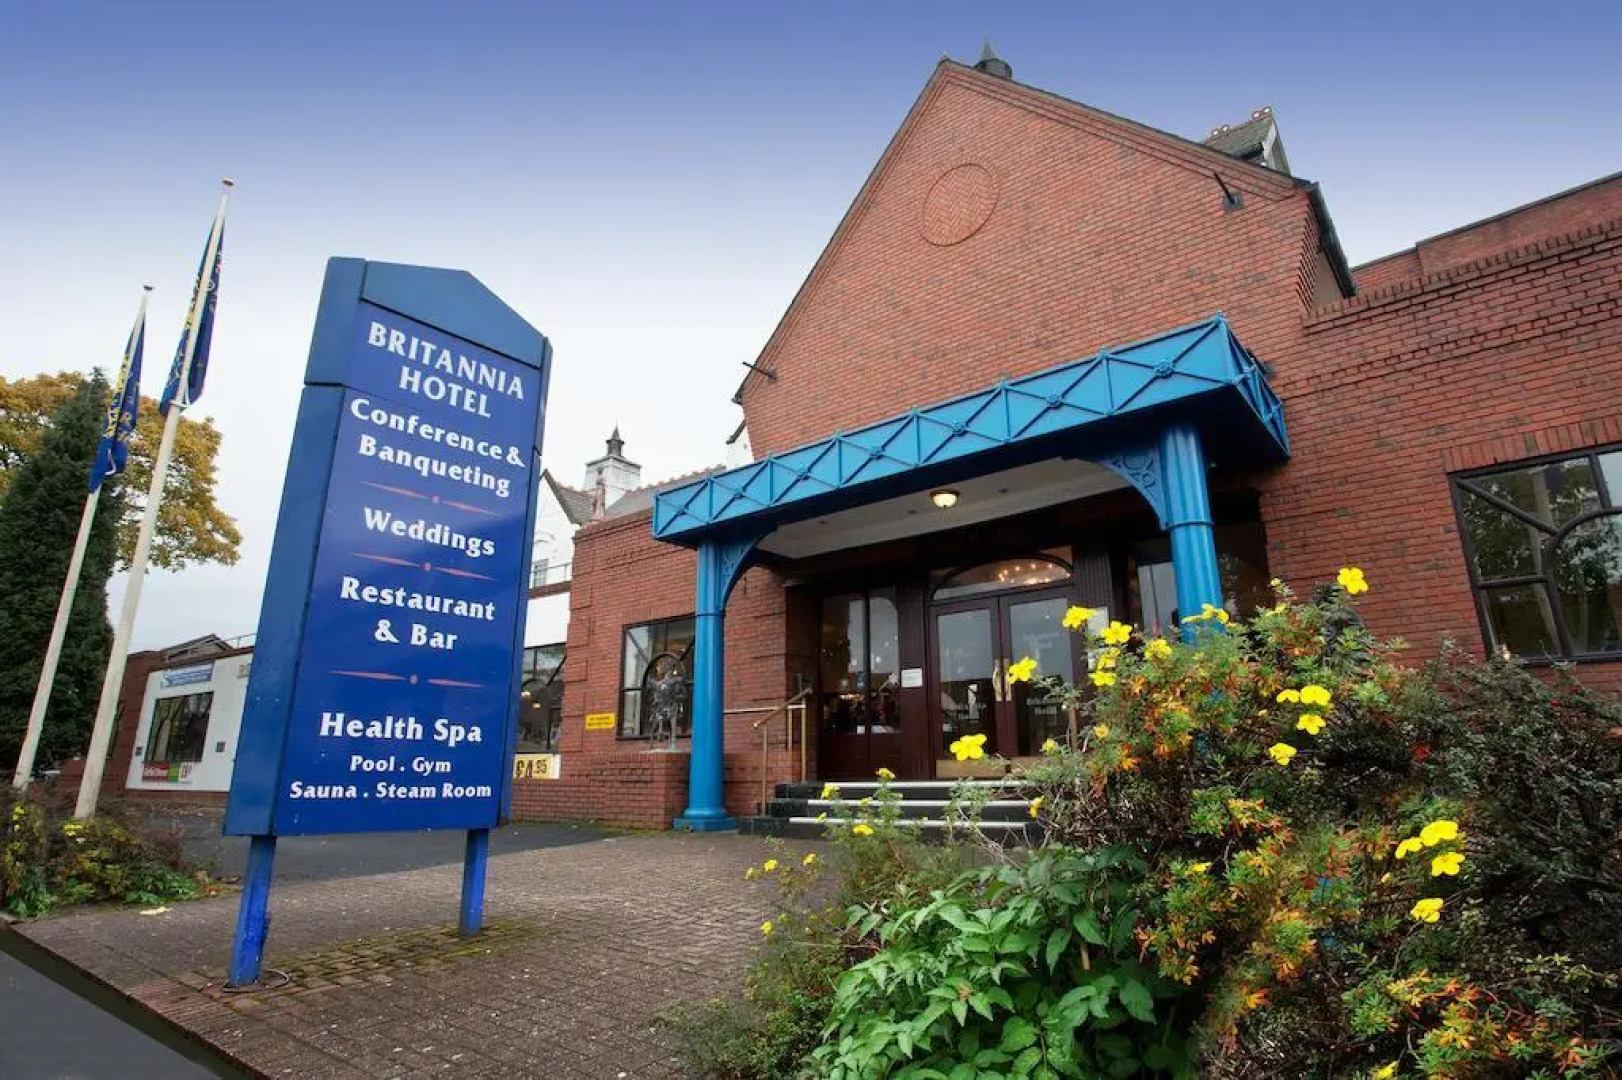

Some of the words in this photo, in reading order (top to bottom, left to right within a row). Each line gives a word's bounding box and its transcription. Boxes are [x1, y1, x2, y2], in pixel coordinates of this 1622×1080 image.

[368, 321, 524, 399] BRITANNIA
[399, 366, 491, 418] HOTEL
[350, 398, 503, 460] Conference
[506, 446, 525, 468] &
[358, 433, 511, 498] Banqueting
[363, 507, 495, 558] Weddings
[340, 576, 495, 621] Restaurant
[374, 619, 399, 643] &
[411, 623, 458, 650] Bar
[319, 712, 424, 741] Health
[433, 718, 482, 747] Spa
[289, 781, 357, 798] Sauna
[375, 782, 436, 798] Steam
[441, 783, 492, 798] Room
[350, 755, 395, 772] Pool
[412, 757, 451, 776] Gym
